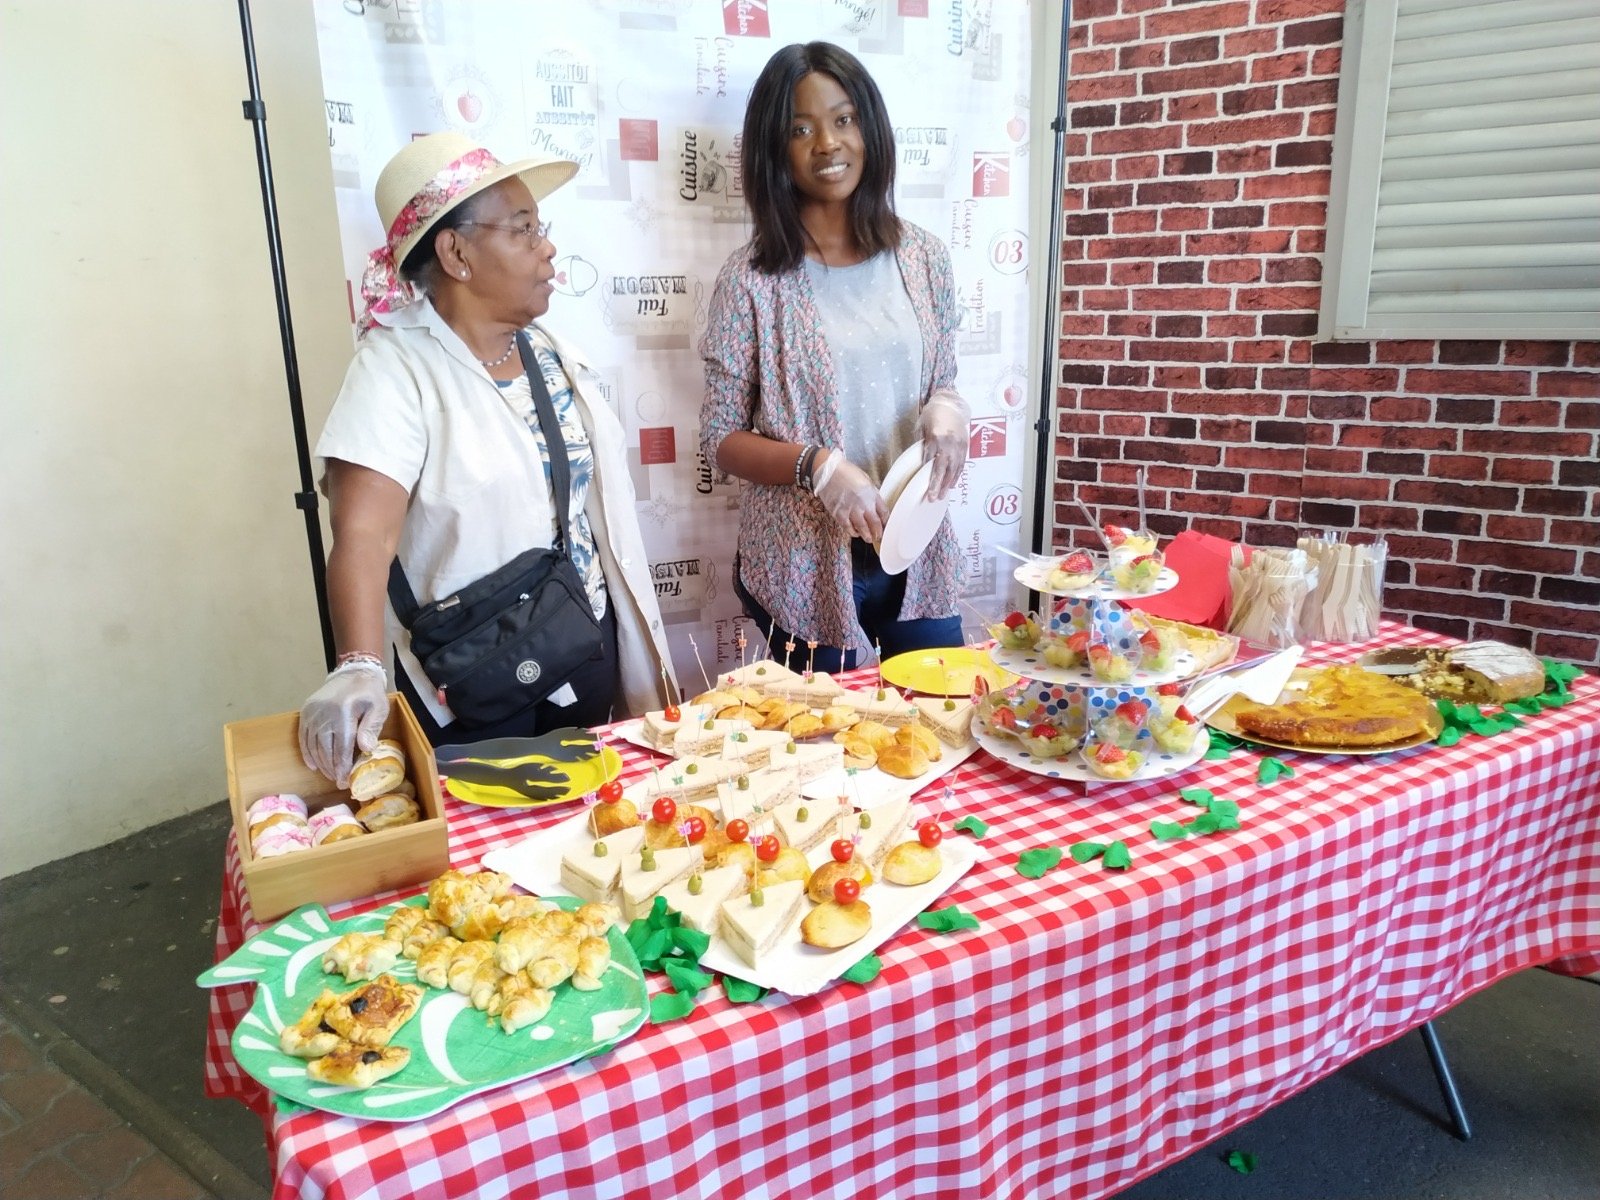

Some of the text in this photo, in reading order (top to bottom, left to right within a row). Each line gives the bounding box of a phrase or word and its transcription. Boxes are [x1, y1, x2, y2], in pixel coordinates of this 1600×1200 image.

[947, 0, 963, 57] Cuisin
[551, 85, 574, 108] FAIT
[679, 130, 698, 201] Cuisine
[973, 152, 1009, 197] Kitchen
[994, 240, 1023, 264] 03
[612, 275, 687, 295] MAISON
[970, 417, 1006, 457] Kitchen
[990, 494, 1018, 516] 03
